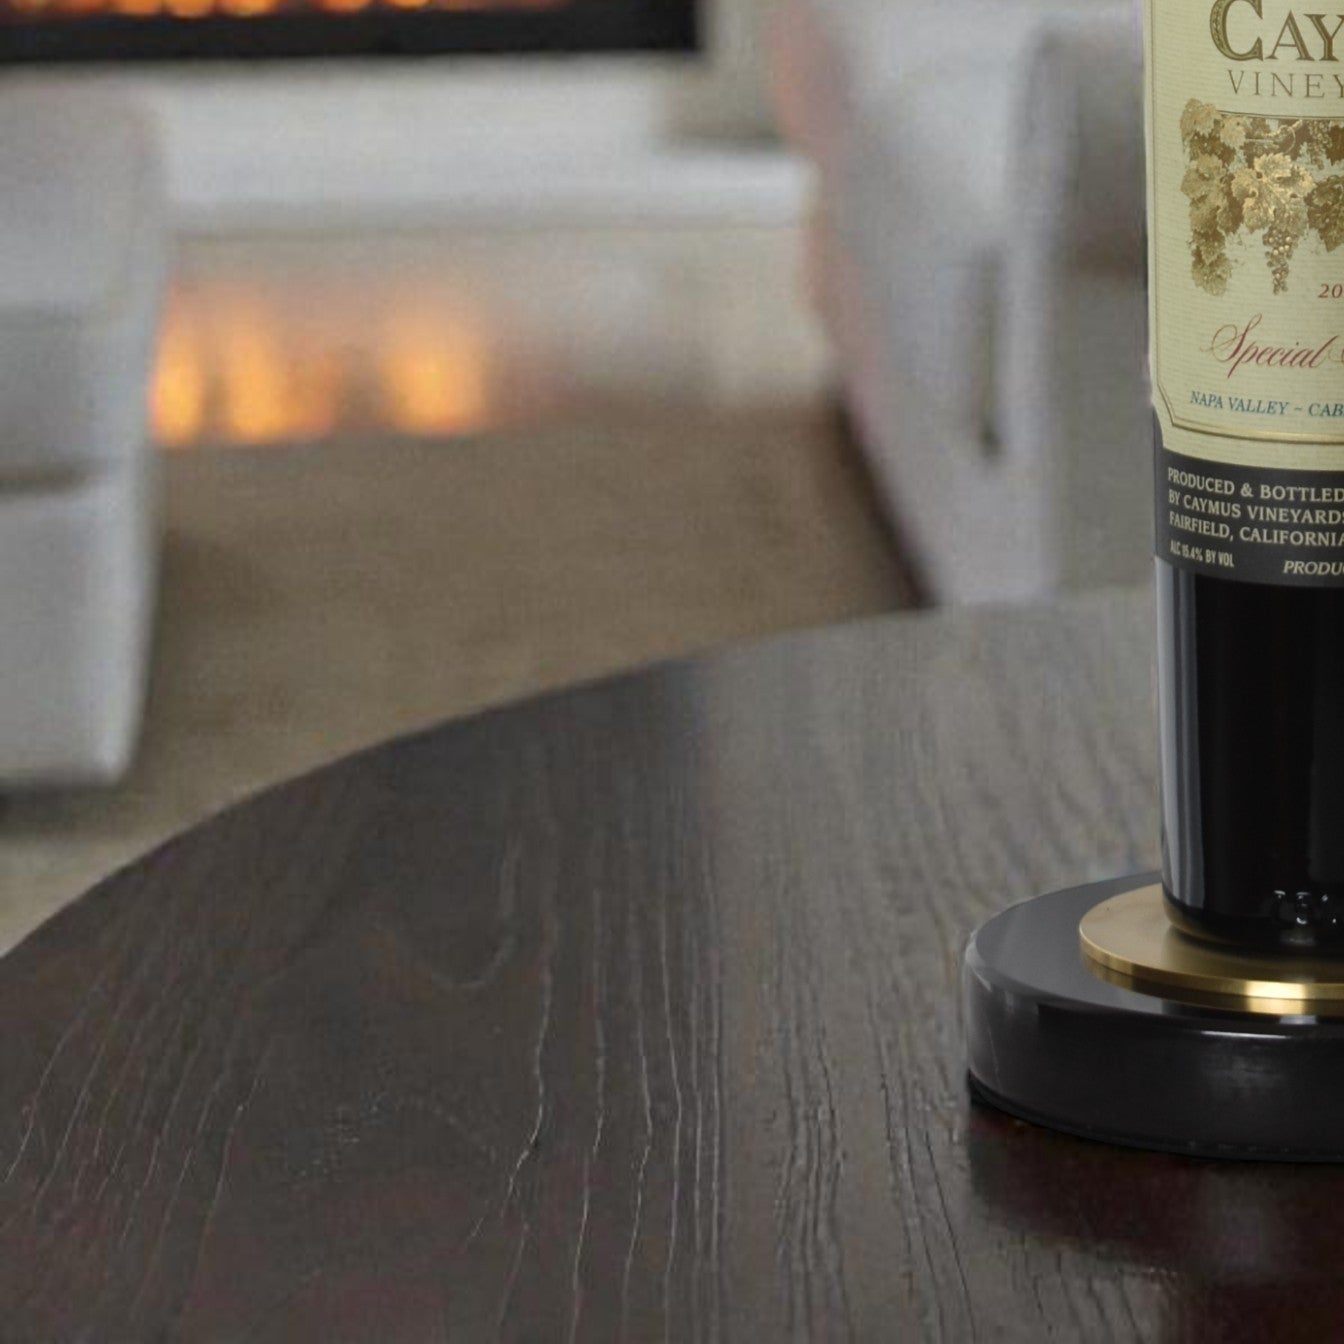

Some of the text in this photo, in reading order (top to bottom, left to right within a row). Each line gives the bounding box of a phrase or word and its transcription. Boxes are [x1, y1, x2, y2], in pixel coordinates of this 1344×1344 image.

[1203, 313, 1339, 379] Special
[1190, 391, 1223, 409] NAPA
[1228, 397, 1290, 416] VALLEY
[1167, 467, 1235, 496] PRODUCED
[1240, 482, 1254, 498] &
[1168, 489, 1181, 506] BY
[1183, 495, 1242, 518] CAYMUS
[1169, 511, 1234, 542] FAIRFIELD,
[1205, 549, 1217, 563] BY
[1218, 552, 1235, 567] VOL
